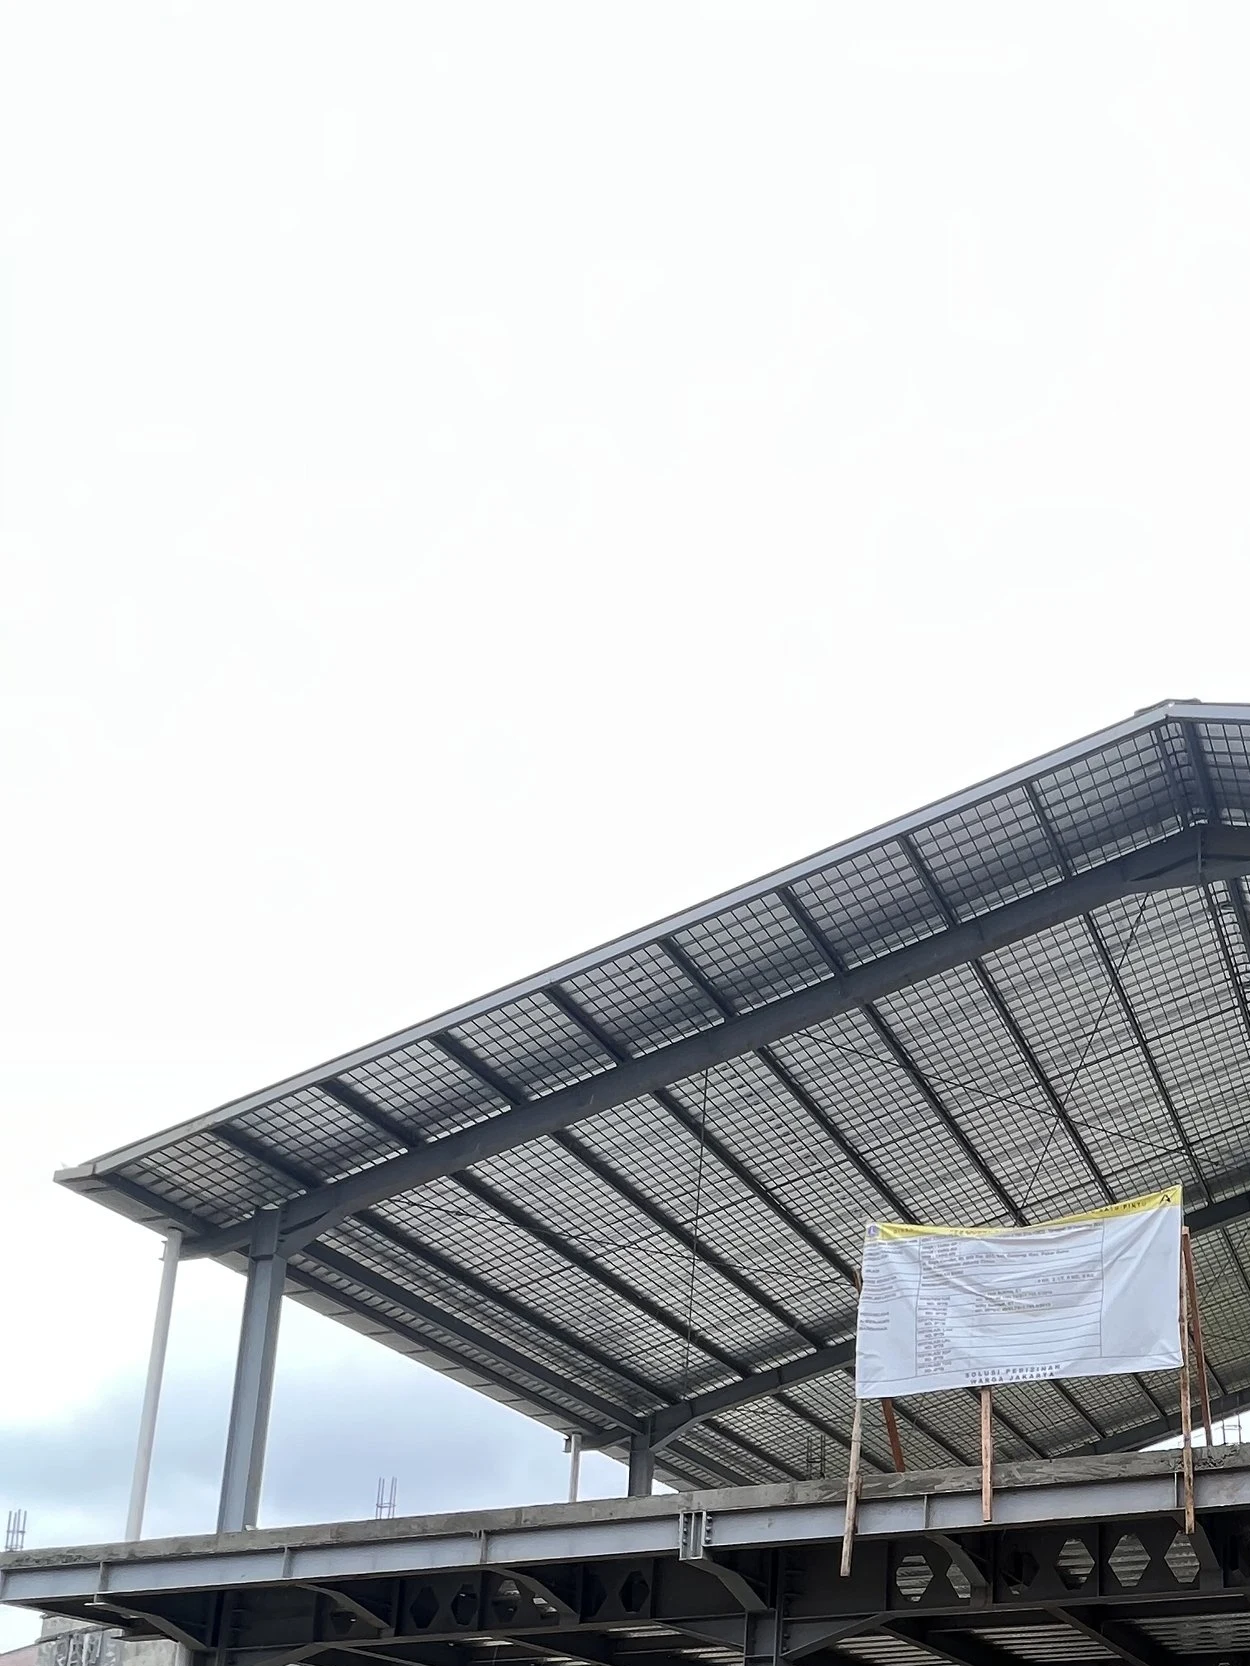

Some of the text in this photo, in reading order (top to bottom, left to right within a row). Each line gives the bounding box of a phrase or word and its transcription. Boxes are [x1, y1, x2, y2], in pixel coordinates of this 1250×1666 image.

[965, 1369, 1001, 1379] SOLUSI
[970, 1372, 1055, 1385] WARGA JAKARTA
